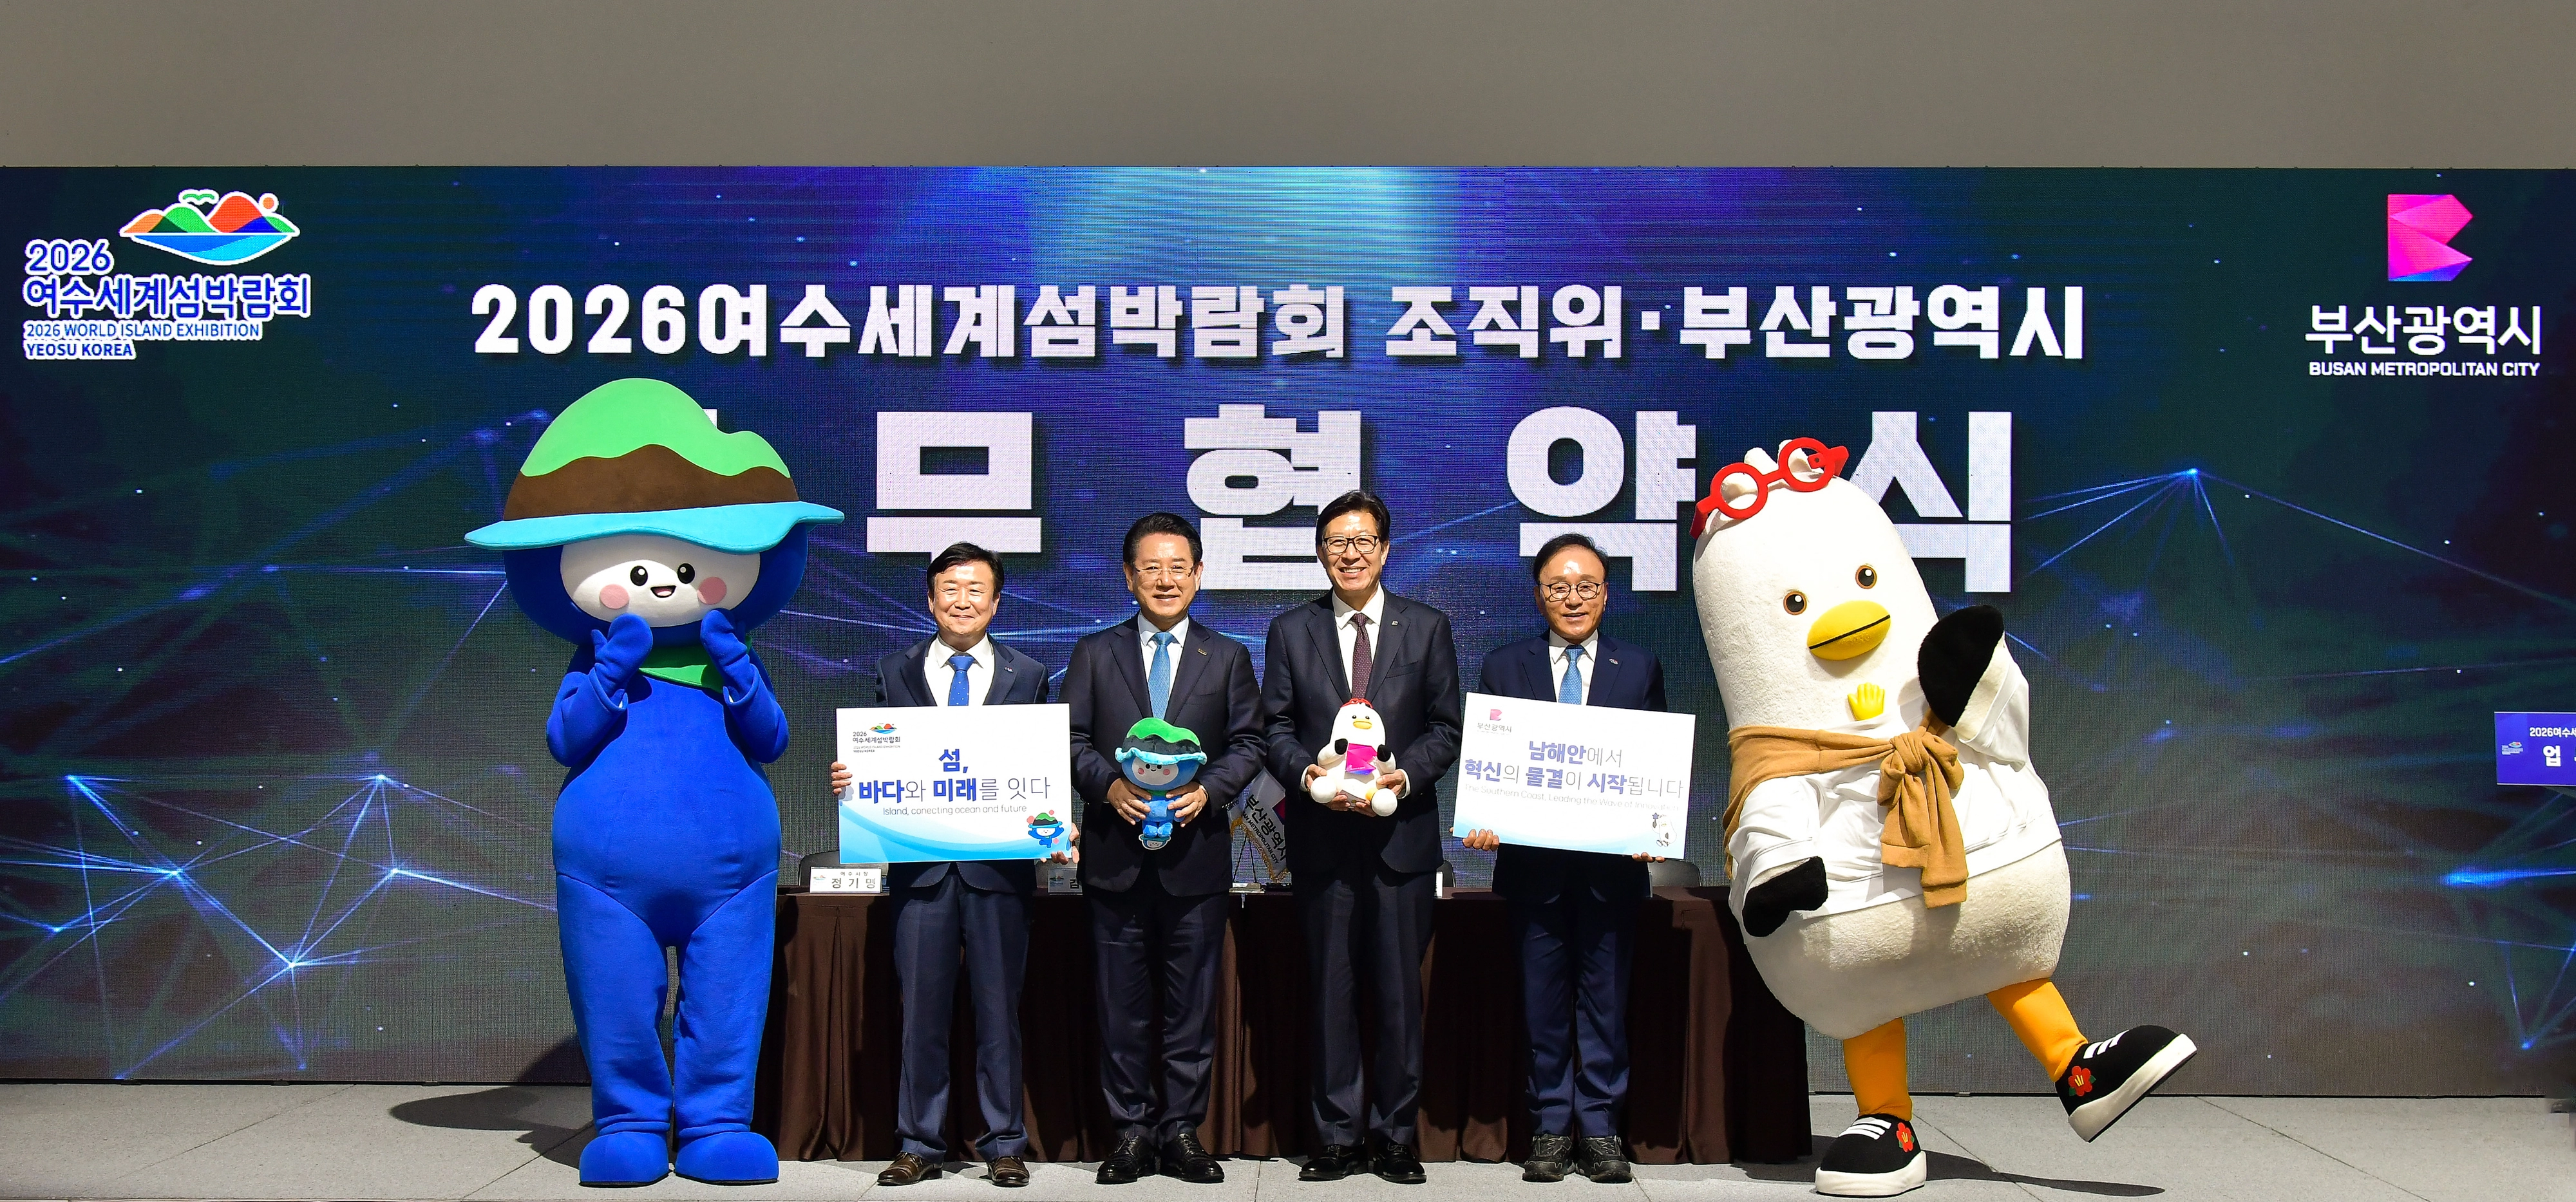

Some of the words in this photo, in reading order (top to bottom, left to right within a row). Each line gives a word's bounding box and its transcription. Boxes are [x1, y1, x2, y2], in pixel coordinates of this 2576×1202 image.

[27, 242, 113, 273] 2026
[24, 276, 310, 319] 여수세계섬박람회
[26, 323, 61, 337] 2026
[64, 323, 117, 337] WORLD
[120, 323, 173, 337] ISLAND
[176, 323, 260, 337] EXHIBITION
[471, 283, 1344, 358] 2026여수세계섬박람회
[2305, 305, 2541, 355] 부산광역시
[27, 343, 77, 357] YEOSU
[82, 343, 133, 357] KOREA
[2309, 361, 2367, 377] BUSAN
[2371, 361, 2498, 377] METROPOLITAN
[2502, 361, 2541, 377] CITY
[1477, 722, 1512, 733] 부산광역시
[938, 749, 968, 773] 섬,
[1529, 740, 1622, 767] 남해안에서
[2543, 745, 2561, 767] 업
[859, 780, 927, 804] 바다와
[933, 778, 999, 802] 미래를
[1008, 776, 1050, 800] 잇다
[1464, 758, 1519, 784] 혁신의
[1526, 766, 1581, 791] 물결이
[1587, 773, 1683, 798] 시작됩니다
[1465, 784, 1479, 793] The
[1481, 785, 1519, 797] Southern
[1520, 790, 1547, 802] Coast,
[1548, 794, 1582, 805] Leading
[1584, 797, 1597, 805] the
[1599, 798, 1622, 807] Wave
[883, 807, 909, 816] Island,
[911, 807, 953, 816] conecting
[982, 805, 999, 813] and
[1247, 820, 1273, 854] METROPOLITAN
[1271, 852, 1279, 864] CITY
